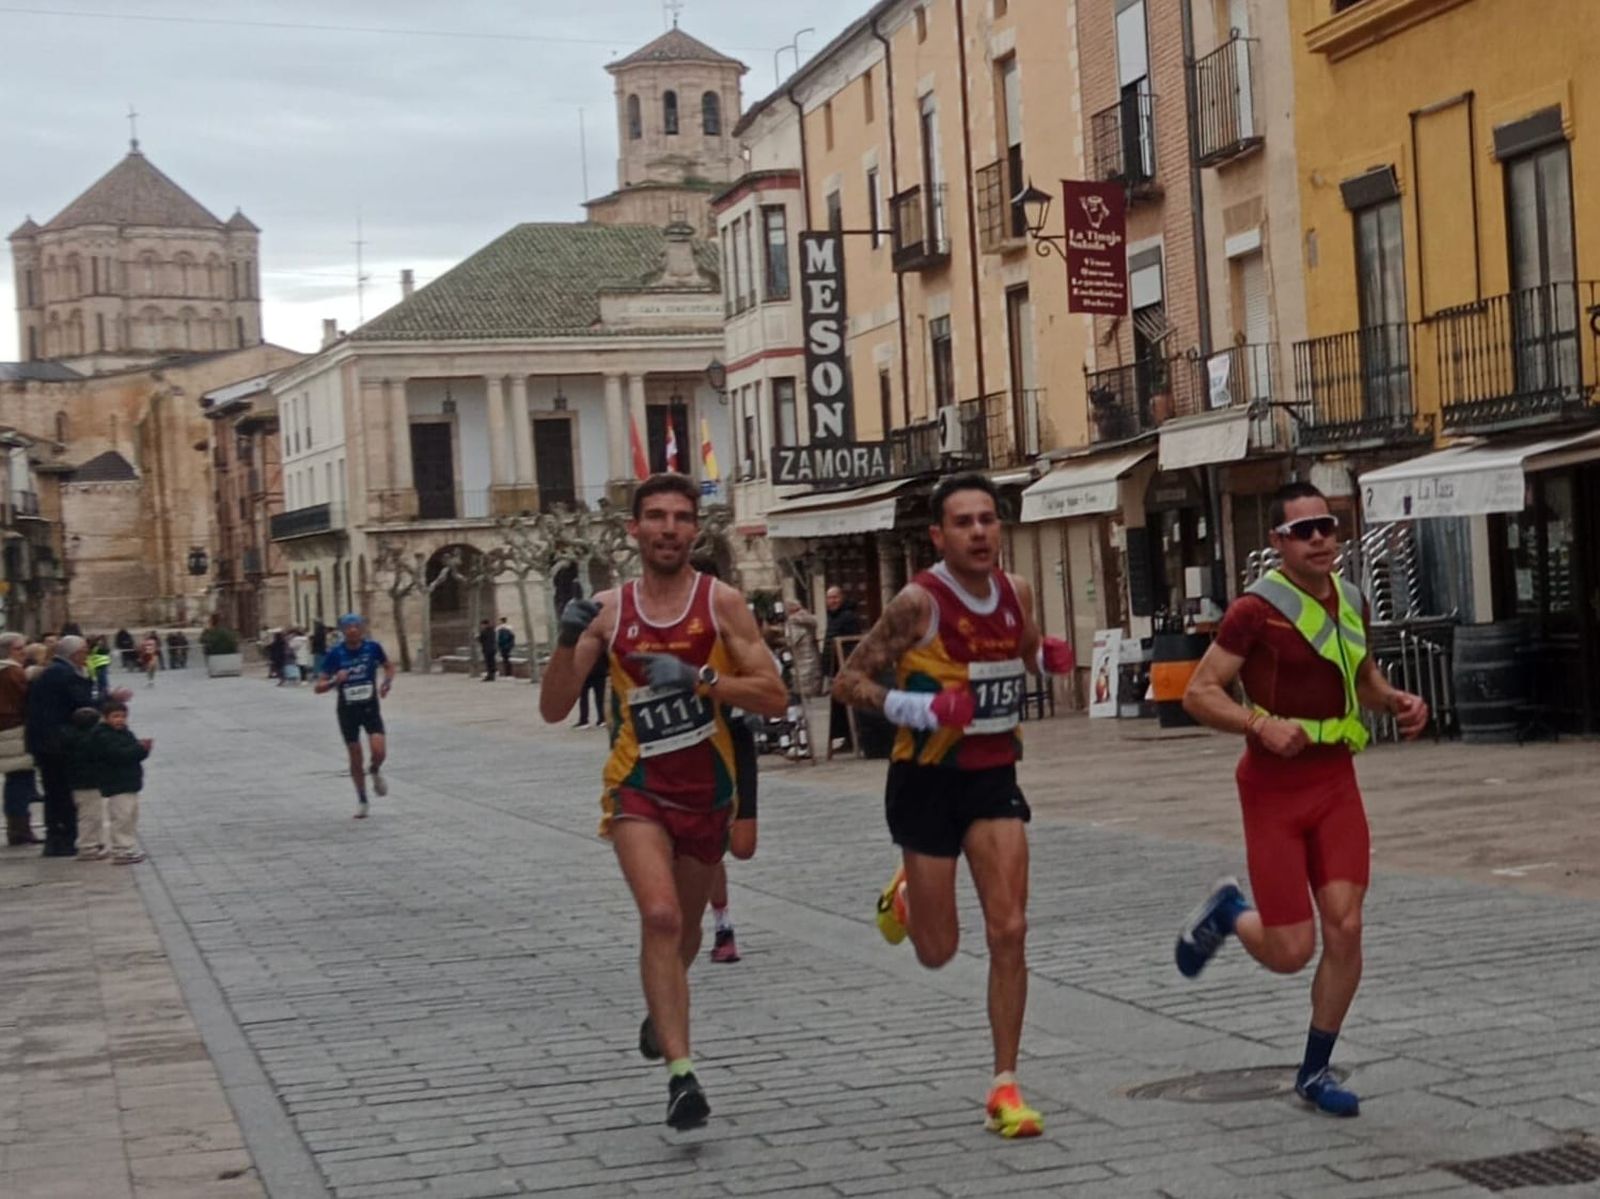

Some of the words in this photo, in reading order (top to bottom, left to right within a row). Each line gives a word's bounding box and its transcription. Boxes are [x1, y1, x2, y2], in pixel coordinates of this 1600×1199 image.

[805, 238, 845, 438] MESON
[779, 446, 886, 481] ZAMORA
[638, 695, 704, 730] 1111
